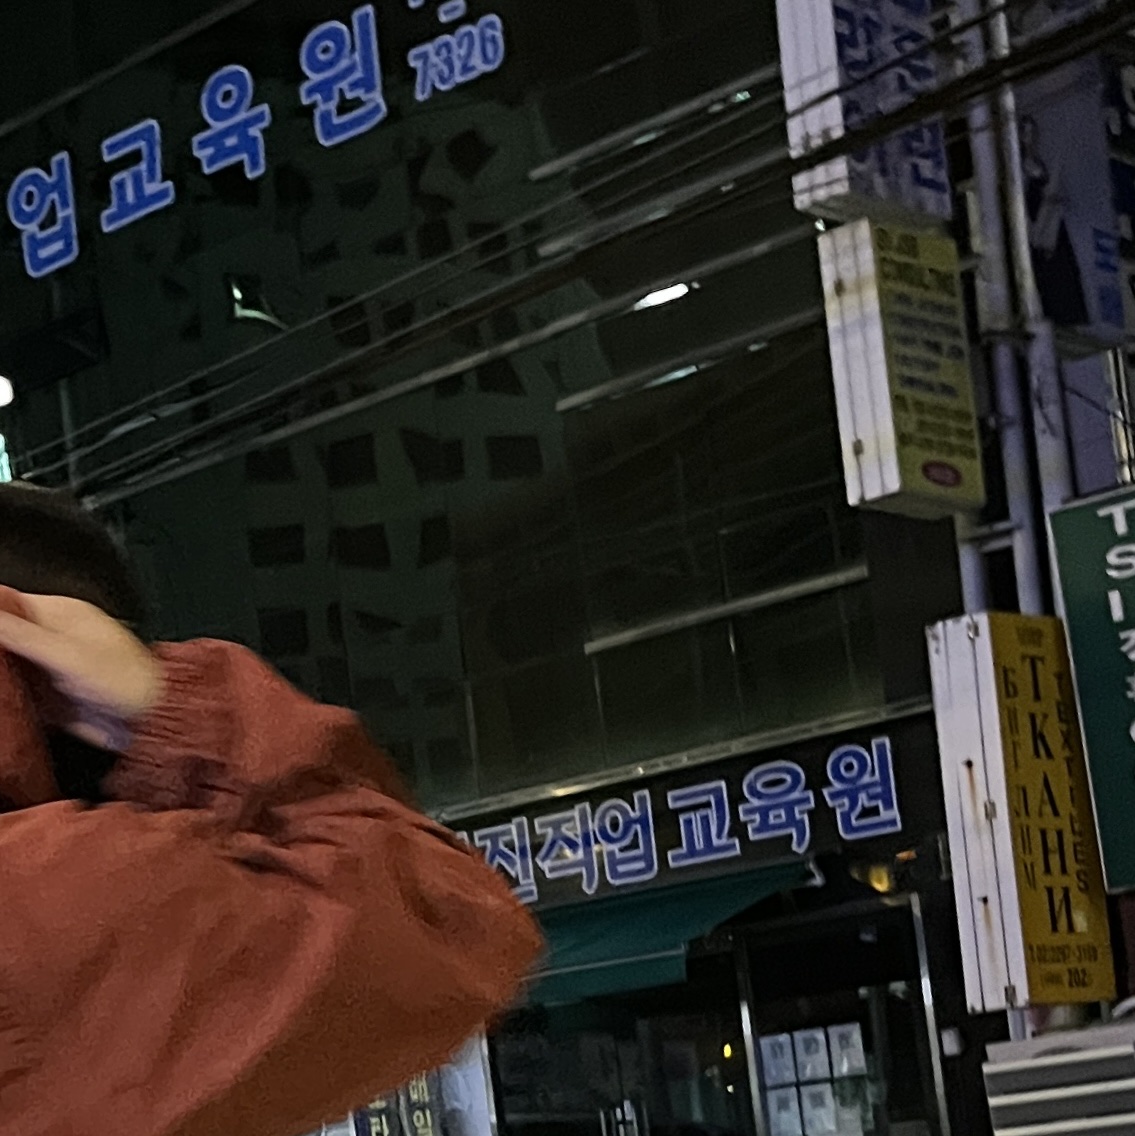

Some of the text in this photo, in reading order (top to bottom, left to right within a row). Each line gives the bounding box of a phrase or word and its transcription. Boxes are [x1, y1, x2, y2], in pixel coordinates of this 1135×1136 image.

[407, 13, 504, 101] 7326
[456, 735, 903, 902] 진직업교육원
[1020, 653, 1076, 934] ТКАНИ
